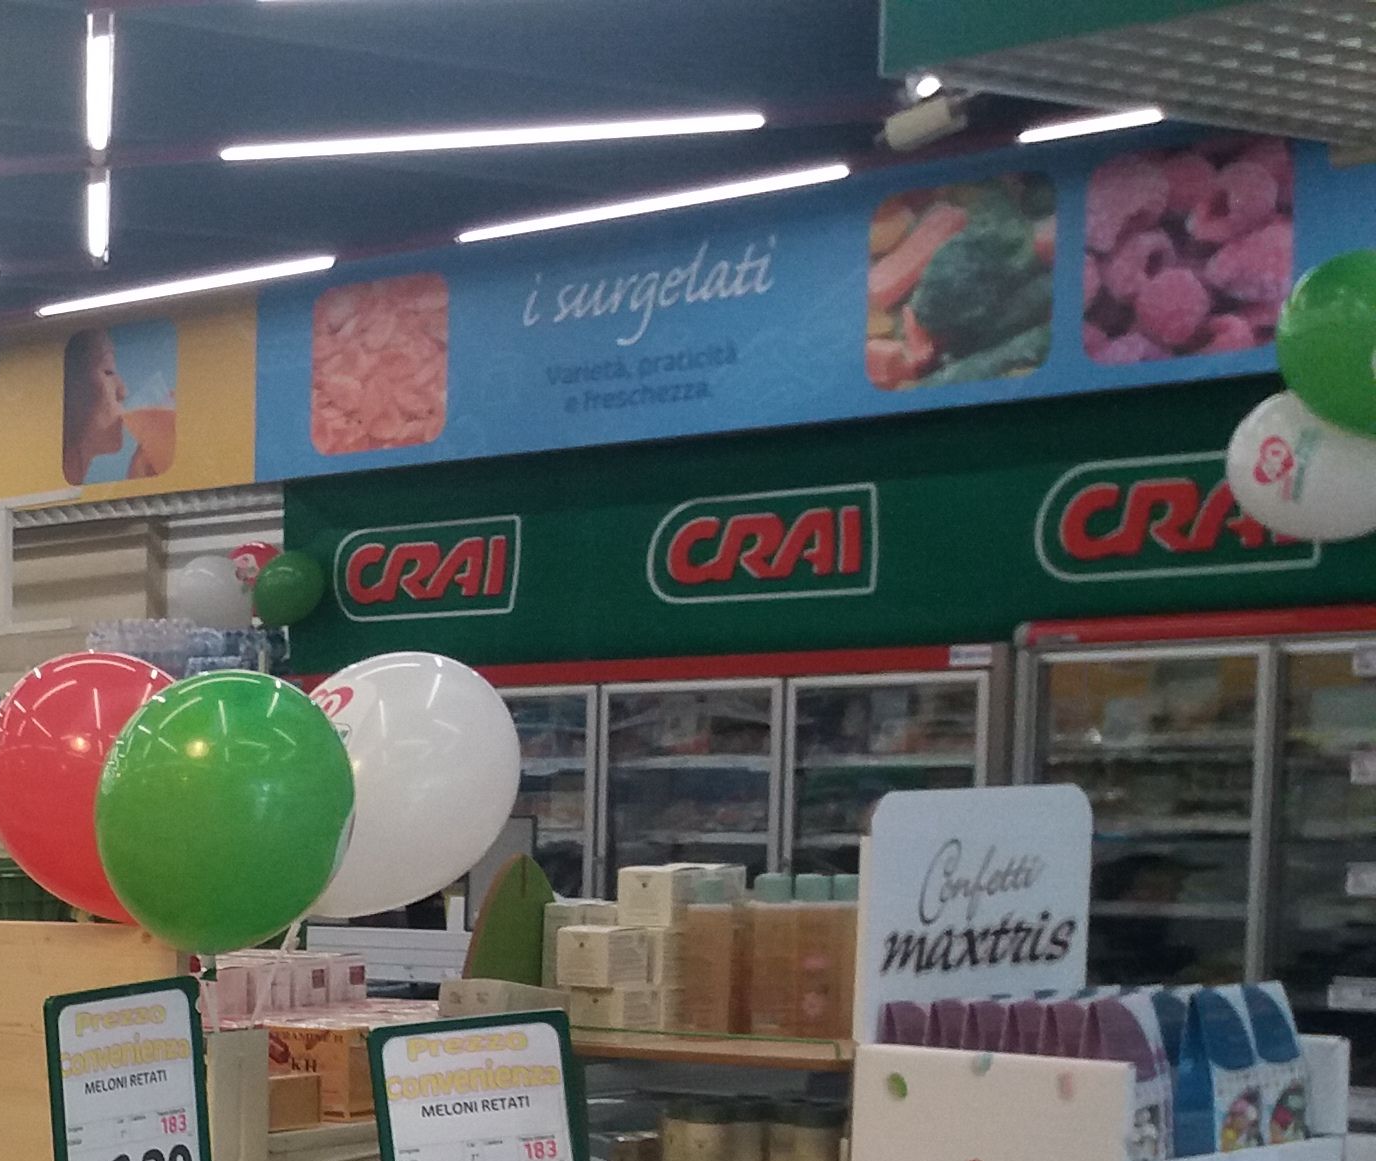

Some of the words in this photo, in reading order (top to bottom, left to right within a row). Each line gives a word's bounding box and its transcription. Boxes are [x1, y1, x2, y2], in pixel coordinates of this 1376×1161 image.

[523, 272, 542, 328] i
[552, 233, 777, 347] surgelati
[667, 505, 863, 585] CRAI
[1060, 477, 1297, 561] CRA
[346, 534, 508, 604] CRAI
[918, 838, 1046, 925] Confetti
[880, 909, 1077, 978] maxtris
[84, 1074, 128, 1096] MELONI
[129, 1069, 168, 1088] RETATI
[421, 1100, 479, 1119] MELONI
[481, 1095, 531, 1113] RETATI
[160, 1113, 188, 1135] 183
[523, 1139, 558, 1161] 183
